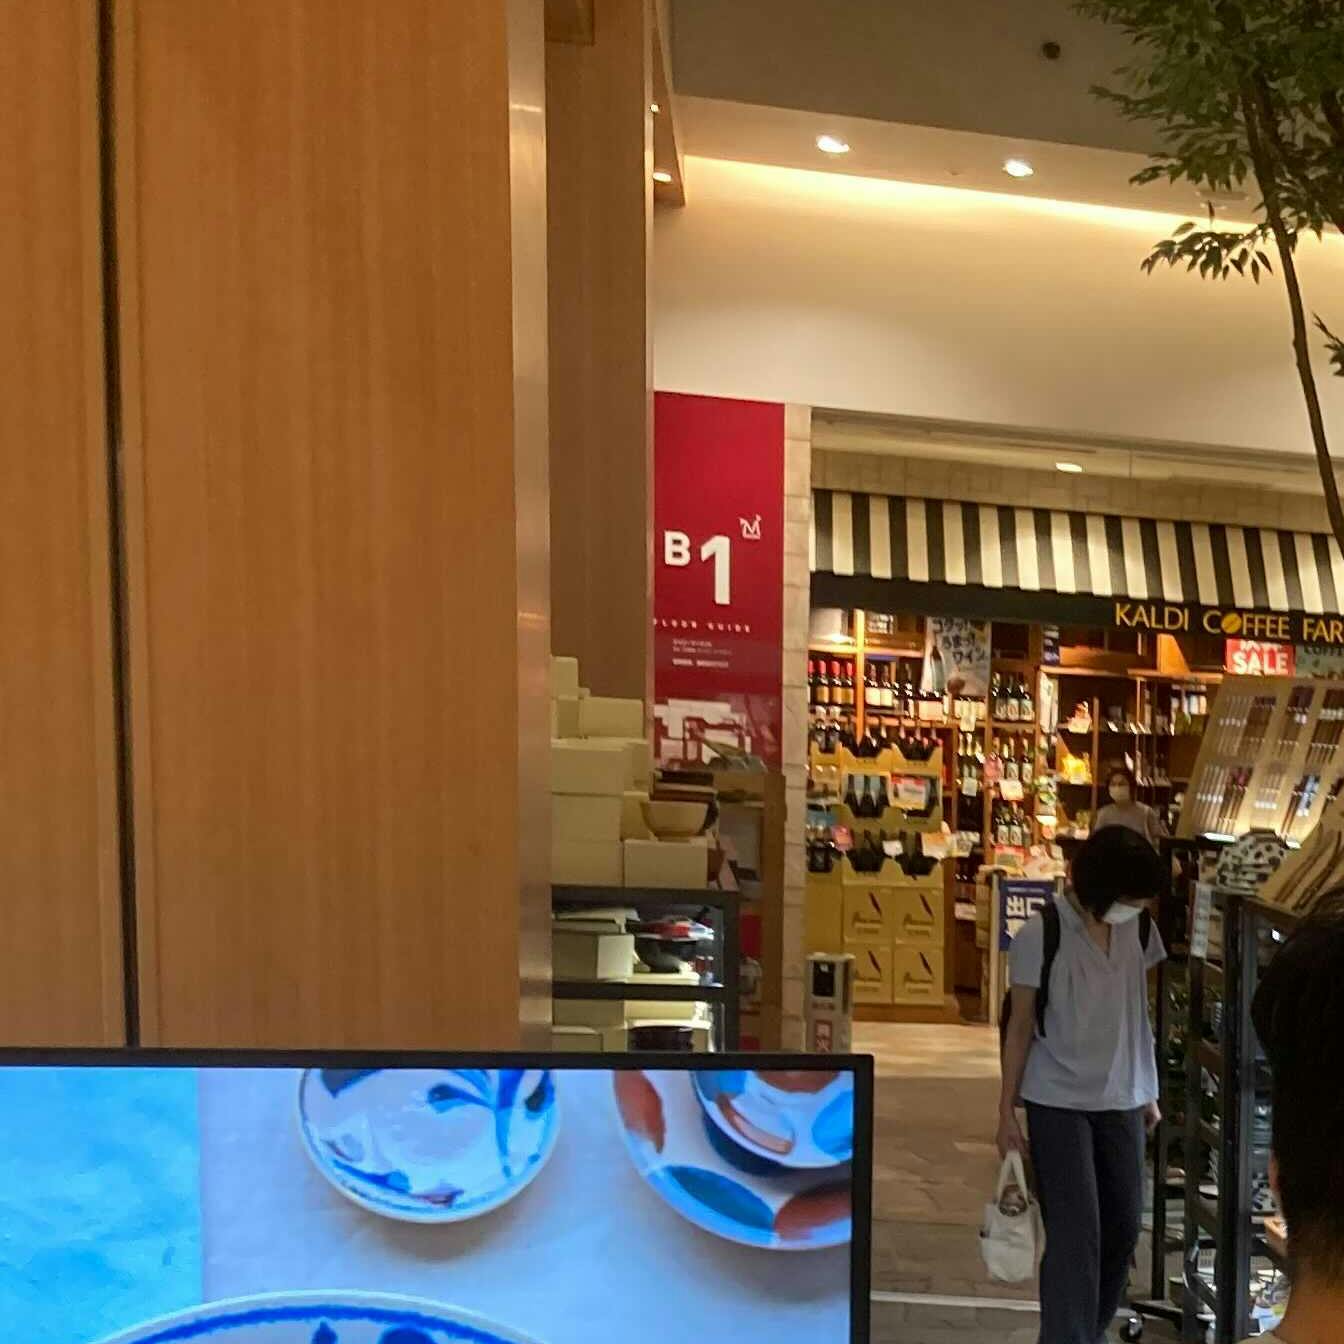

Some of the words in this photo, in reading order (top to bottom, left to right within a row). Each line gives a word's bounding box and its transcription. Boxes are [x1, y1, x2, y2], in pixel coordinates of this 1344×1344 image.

[1115, 603, 1189, 632] KALDI
[1203, 609, 1291, 640] COFFEE
[1232, 650, 1289, 676] SALE
